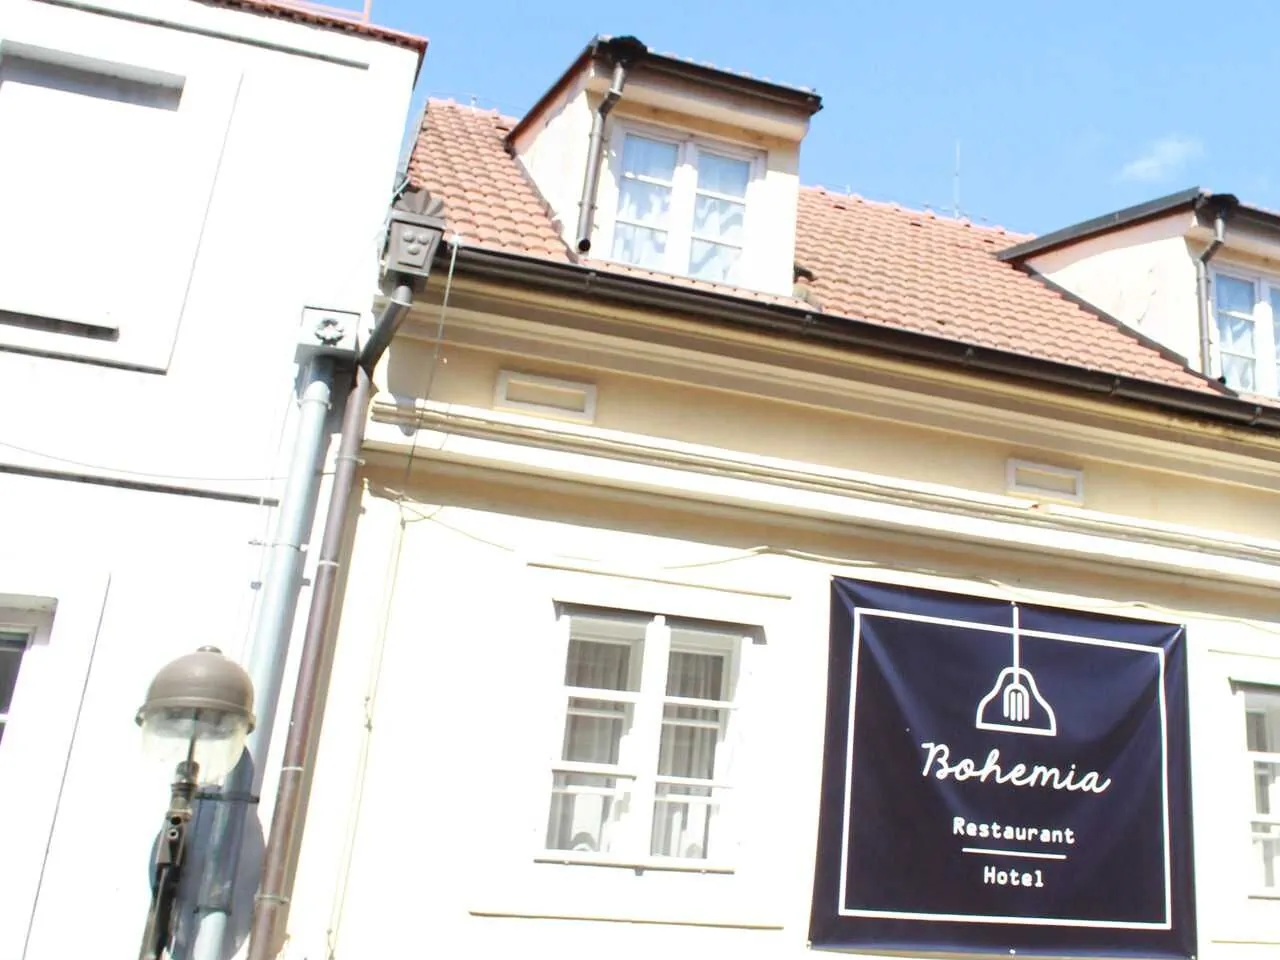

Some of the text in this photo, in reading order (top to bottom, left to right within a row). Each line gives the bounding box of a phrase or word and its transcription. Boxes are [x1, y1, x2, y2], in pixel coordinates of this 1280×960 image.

[921, 741, 1111, 794] Bohemia
[952, 816, 1076, 844] Restaurant
[983, 866, 1045, 888] Hotel
